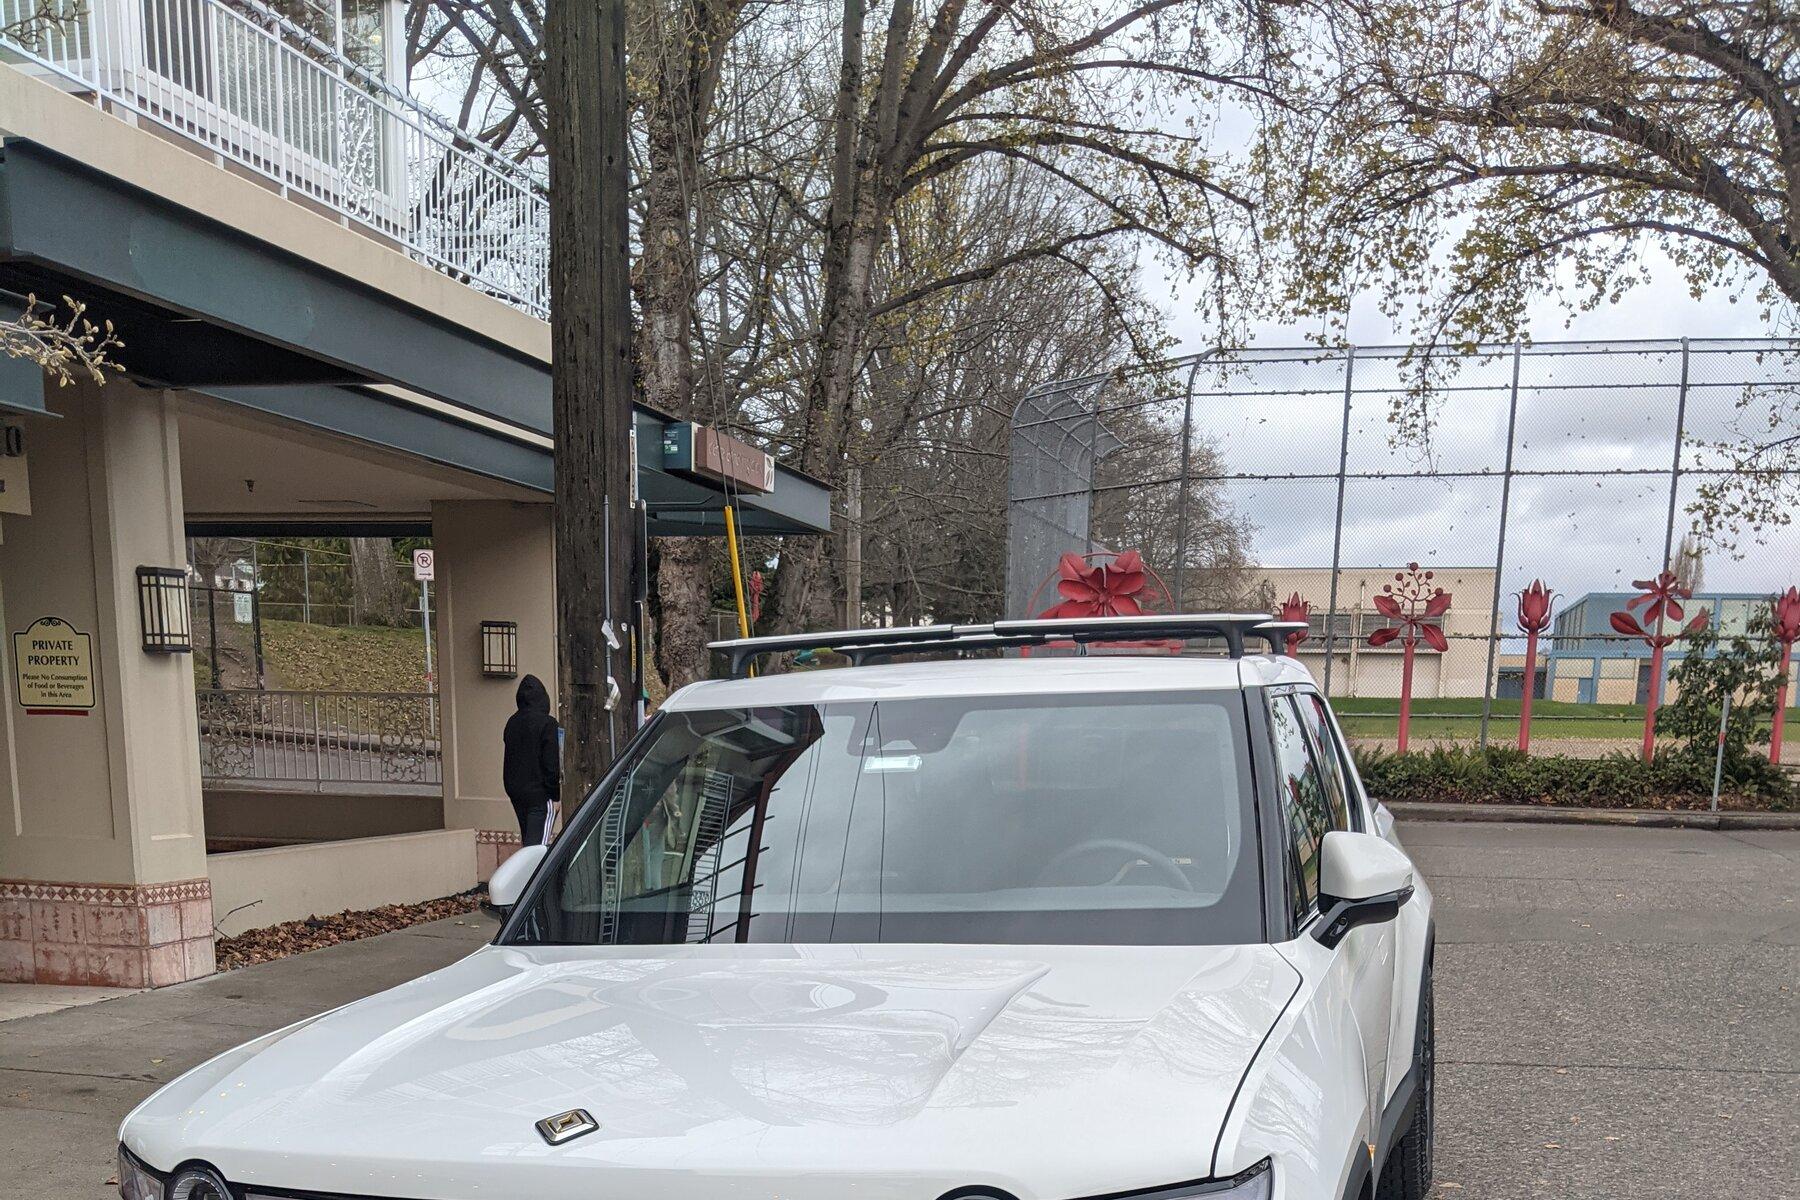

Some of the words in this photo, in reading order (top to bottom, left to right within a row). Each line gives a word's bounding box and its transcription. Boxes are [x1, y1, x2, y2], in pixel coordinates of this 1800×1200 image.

[32, 640, 73, 650] PRIVATE
[28, 655, 79, 665] PROPERTY
[50, 674, 88, 682] Consumption
[56, 683, 84, 691] Beverages
